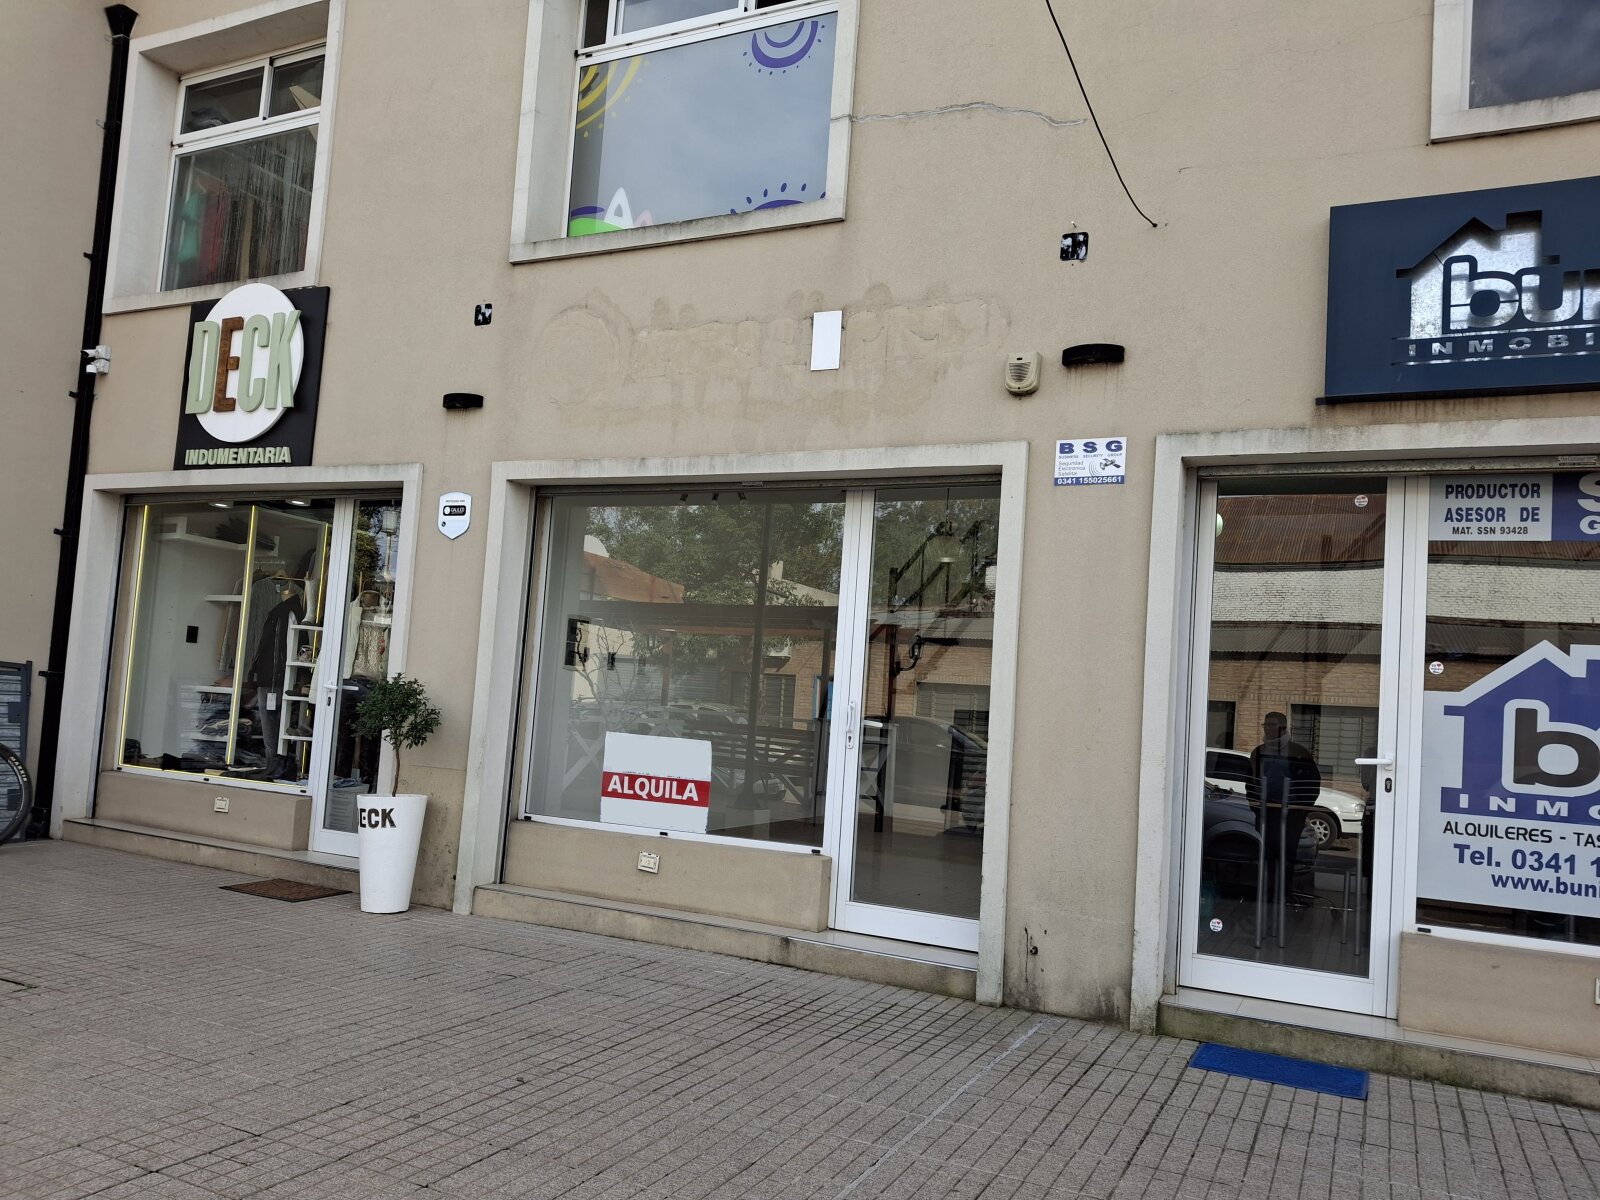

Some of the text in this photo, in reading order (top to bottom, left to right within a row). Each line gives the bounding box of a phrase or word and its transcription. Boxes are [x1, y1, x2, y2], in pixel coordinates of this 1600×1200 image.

[1408, 332, 1595, 357] INMOBI
[185, 309, 302, 415] DECK
[184, 446, 292, 466] INDUMENTARIA
[1057, 475, 1121, 485] 0341 155025661
[1445, 483, 1541, 499] PRODUCTOR
[1444, 506, 1540, 523] ASESOR DE
[1452, 526, 1529, 535] MAT. SSN 93428
[607, 775, 699, 802] ALQUILA
[1443, 820, 1553, 844] ALQUILERES
[1453, 843, 1501, 868] Tel.
[1511, 849, 1576, 875] 0341
